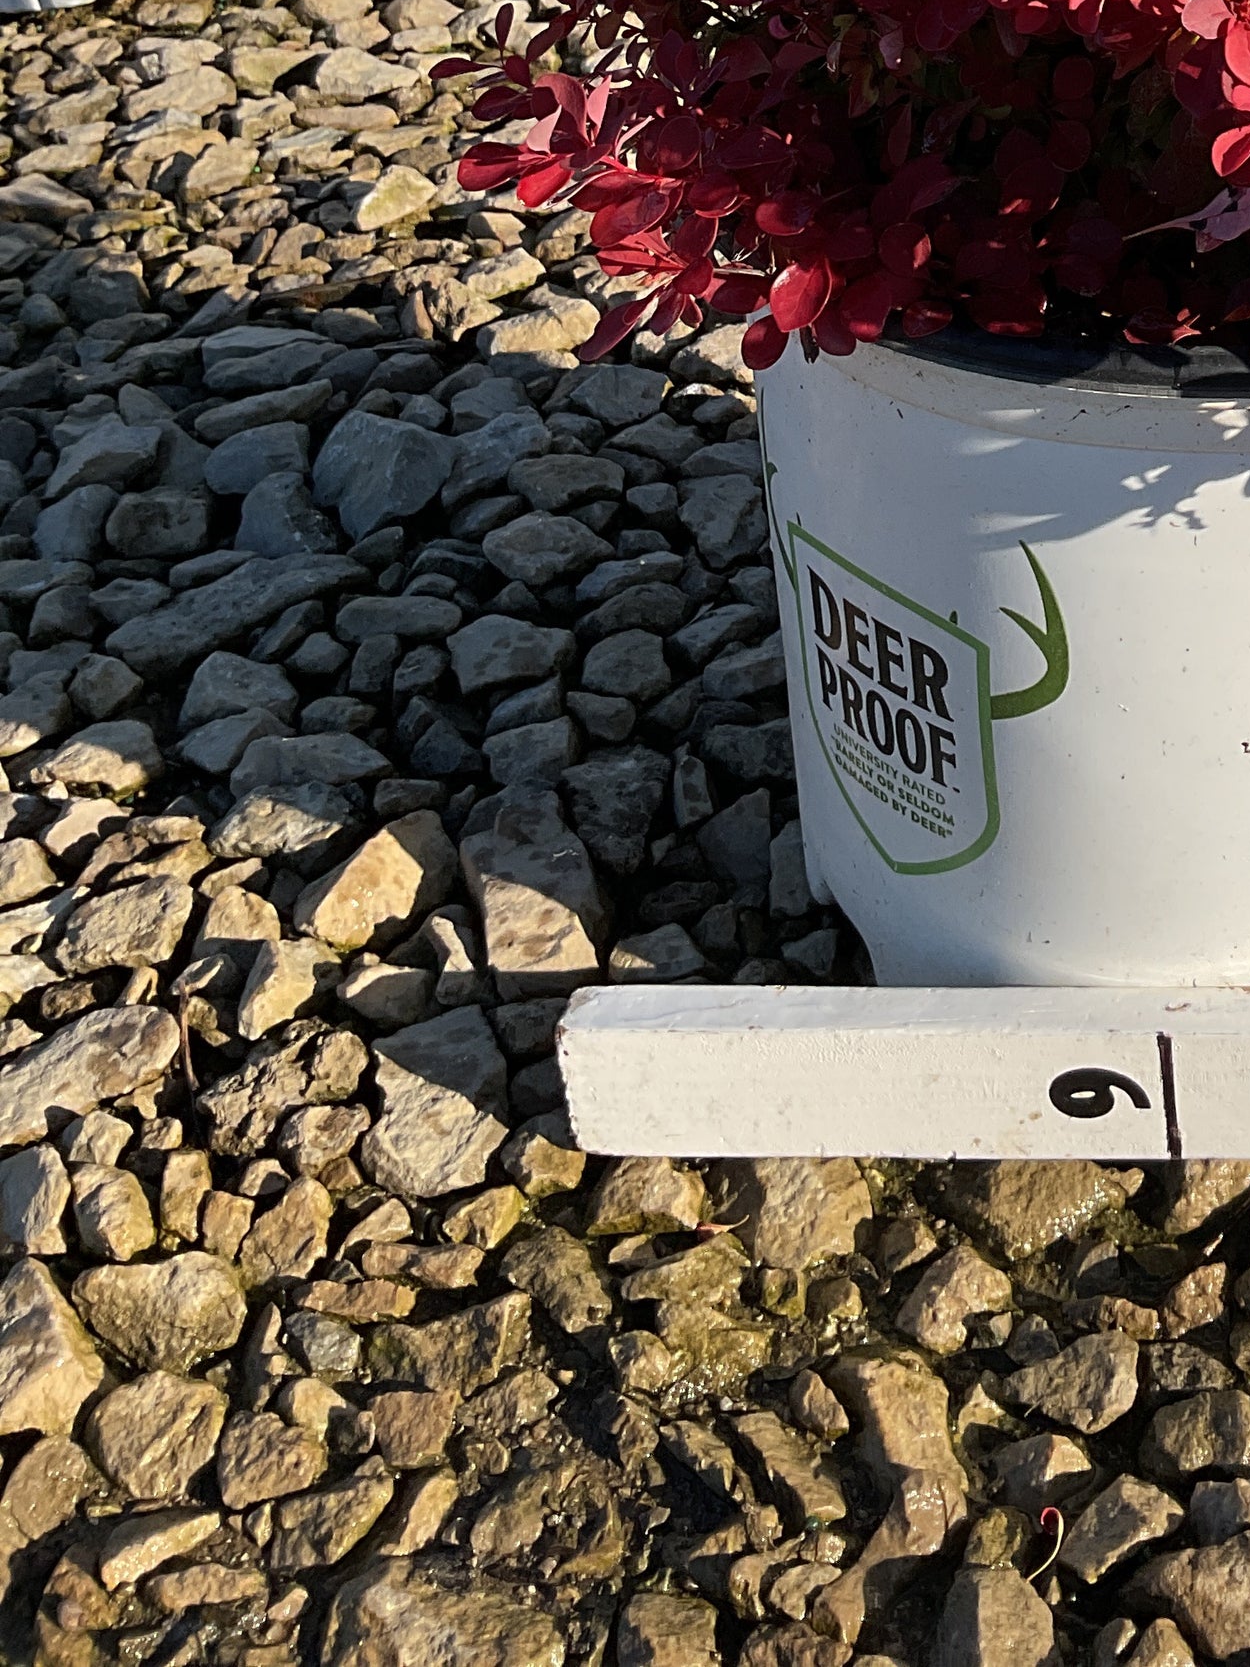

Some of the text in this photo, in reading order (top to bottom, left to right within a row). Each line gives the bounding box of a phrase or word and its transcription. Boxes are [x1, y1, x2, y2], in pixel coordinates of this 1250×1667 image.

[806, 565, 955, 723] DEER
[833, 722, 946, 805] UNIVERSITY RATED
[877, 774, 895, 794] OR
[898, 787, 955, 827] SELDOM
[892, 799, 908, 816] BY
[1048, 1067, 1152, 1119] 6
